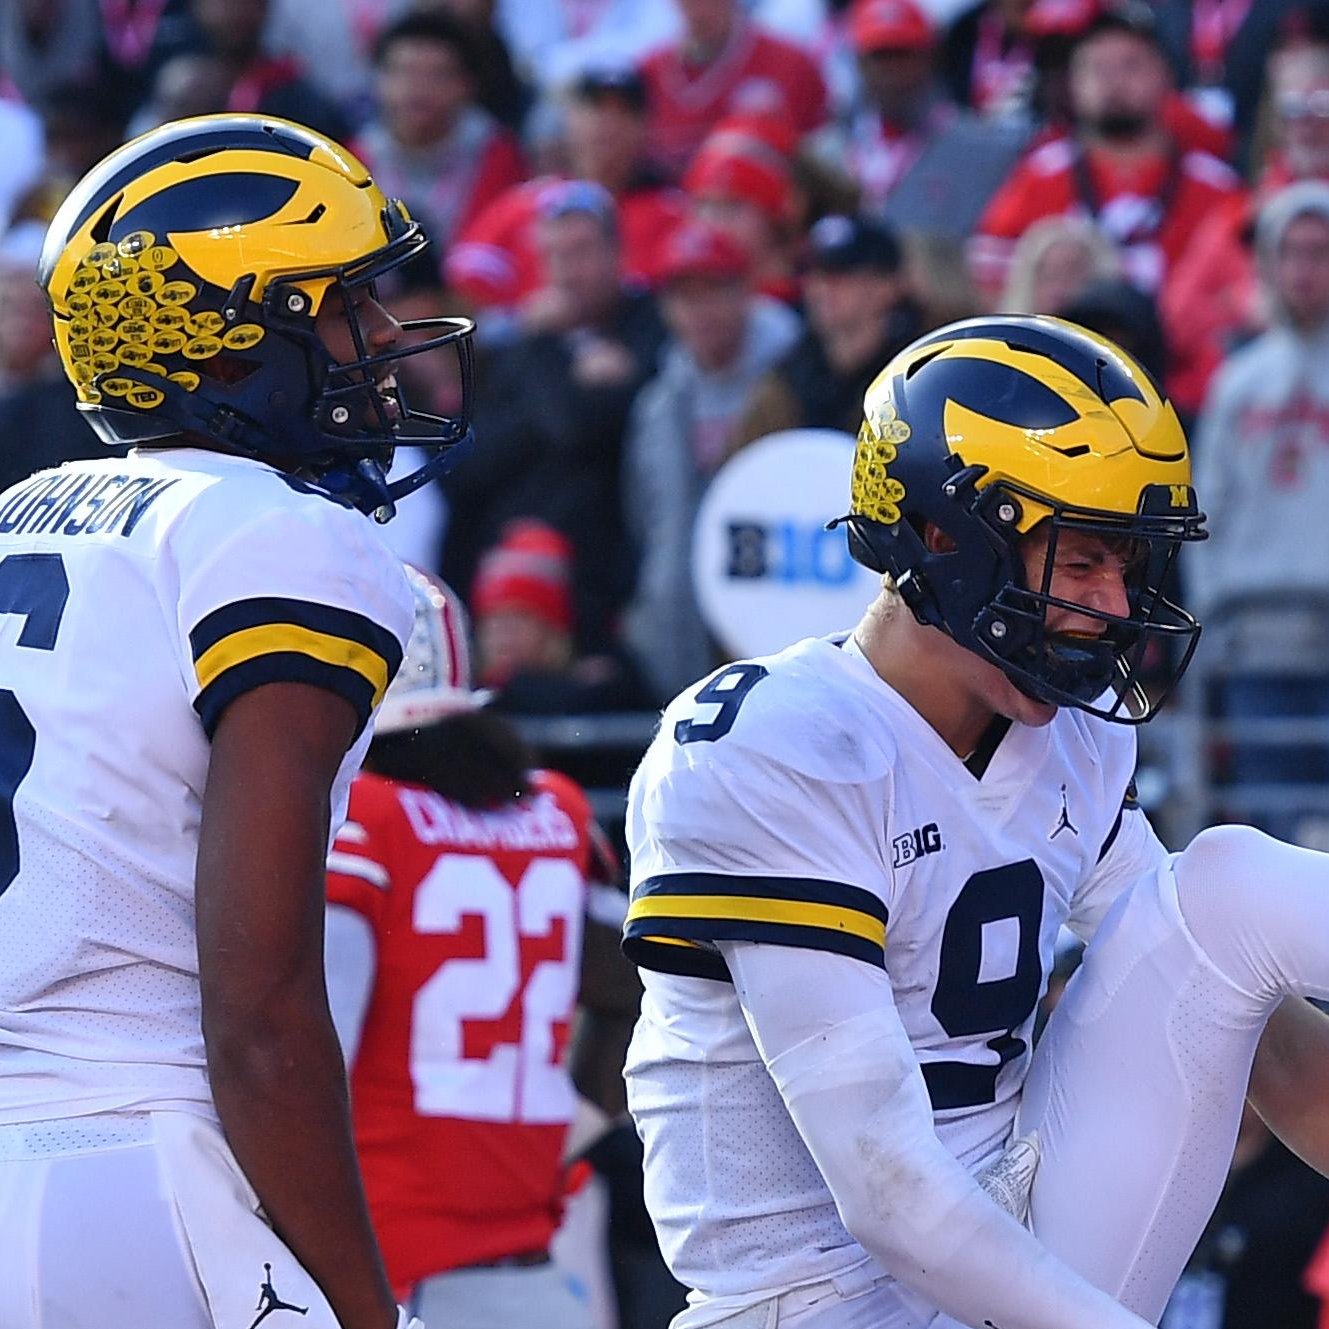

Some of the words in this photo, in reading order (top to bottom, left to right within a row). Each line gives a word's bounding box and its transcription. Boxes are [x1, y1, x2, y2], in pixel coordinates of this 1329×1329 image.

[131, 391, 158, 403] TED
[1169, 486, 1189, 507] M
[673, 663, 770, 746] 9
[410, 853, 585, 1125] 22
[921, 858, 1045, 1111] 9
